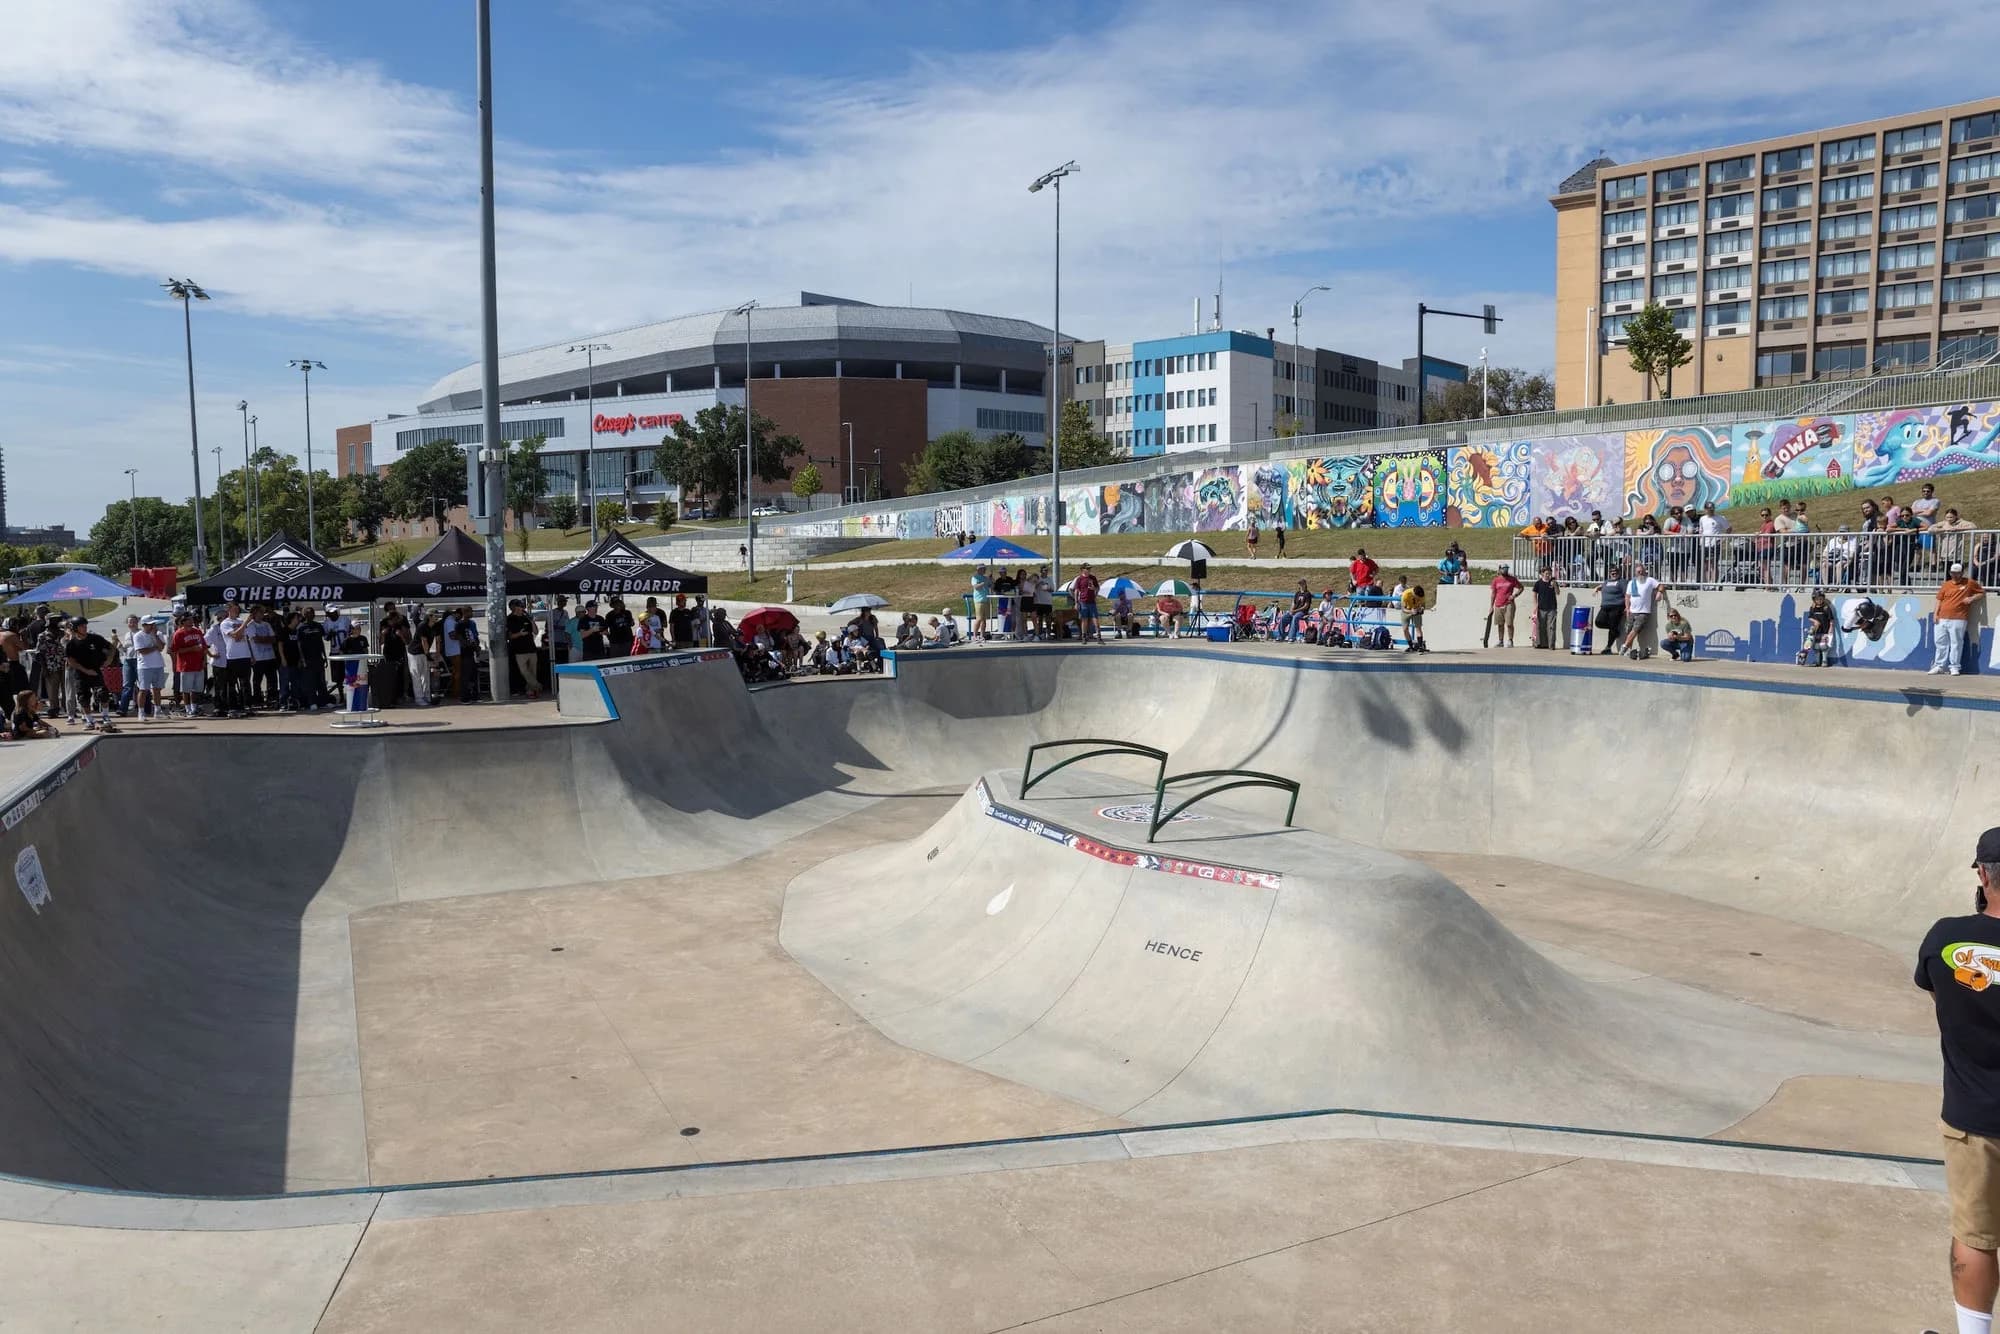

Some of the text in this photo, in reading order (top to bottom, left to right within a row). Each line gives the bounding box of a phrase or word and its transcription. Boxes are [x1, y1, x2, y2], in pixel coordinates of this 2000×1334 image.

[594, 412, 636, 435] Casey's
[1773, 428, 1818, 468] IOWA
[1144, 940, 1203, 962] HENCE
